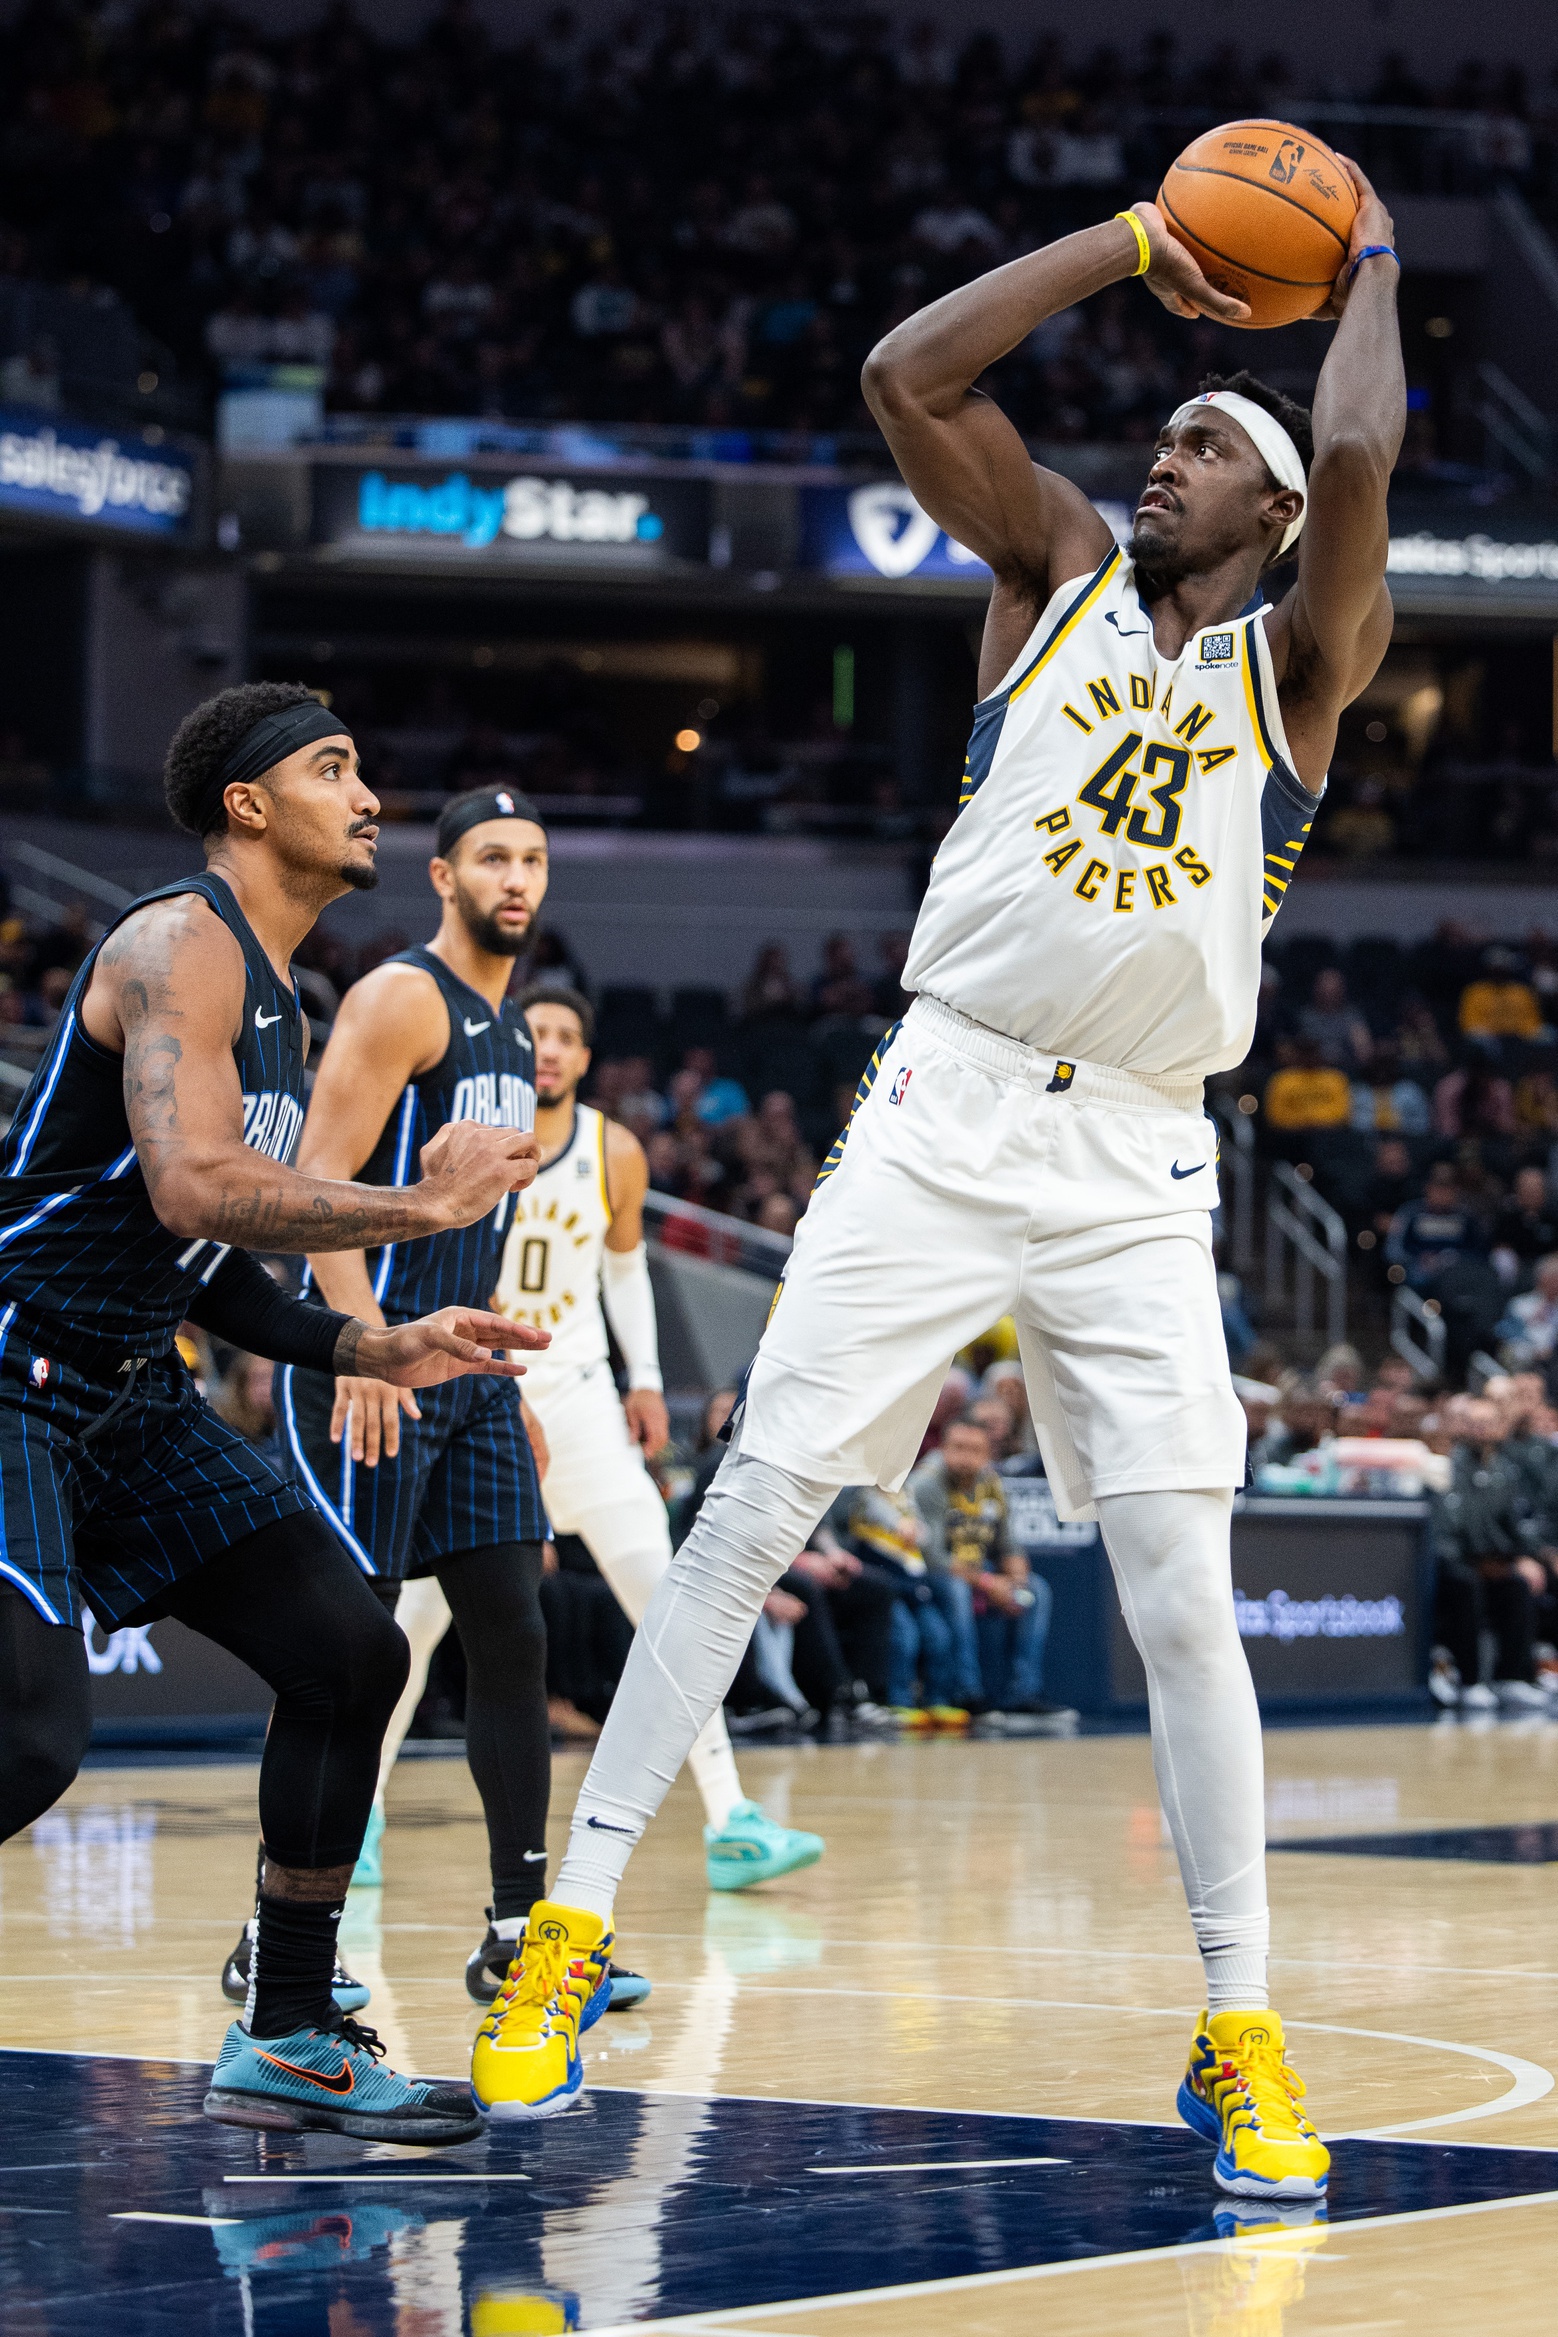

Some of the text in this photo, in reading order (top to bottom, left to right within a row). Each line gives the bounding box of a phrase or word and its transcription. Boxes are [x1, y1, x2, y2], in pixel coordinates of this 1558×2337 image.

[1194, 661, 1239, 671] spokenote
[1075, 729, 1193, 851] 43
[1033, 803, 1214, 913] PACERS
